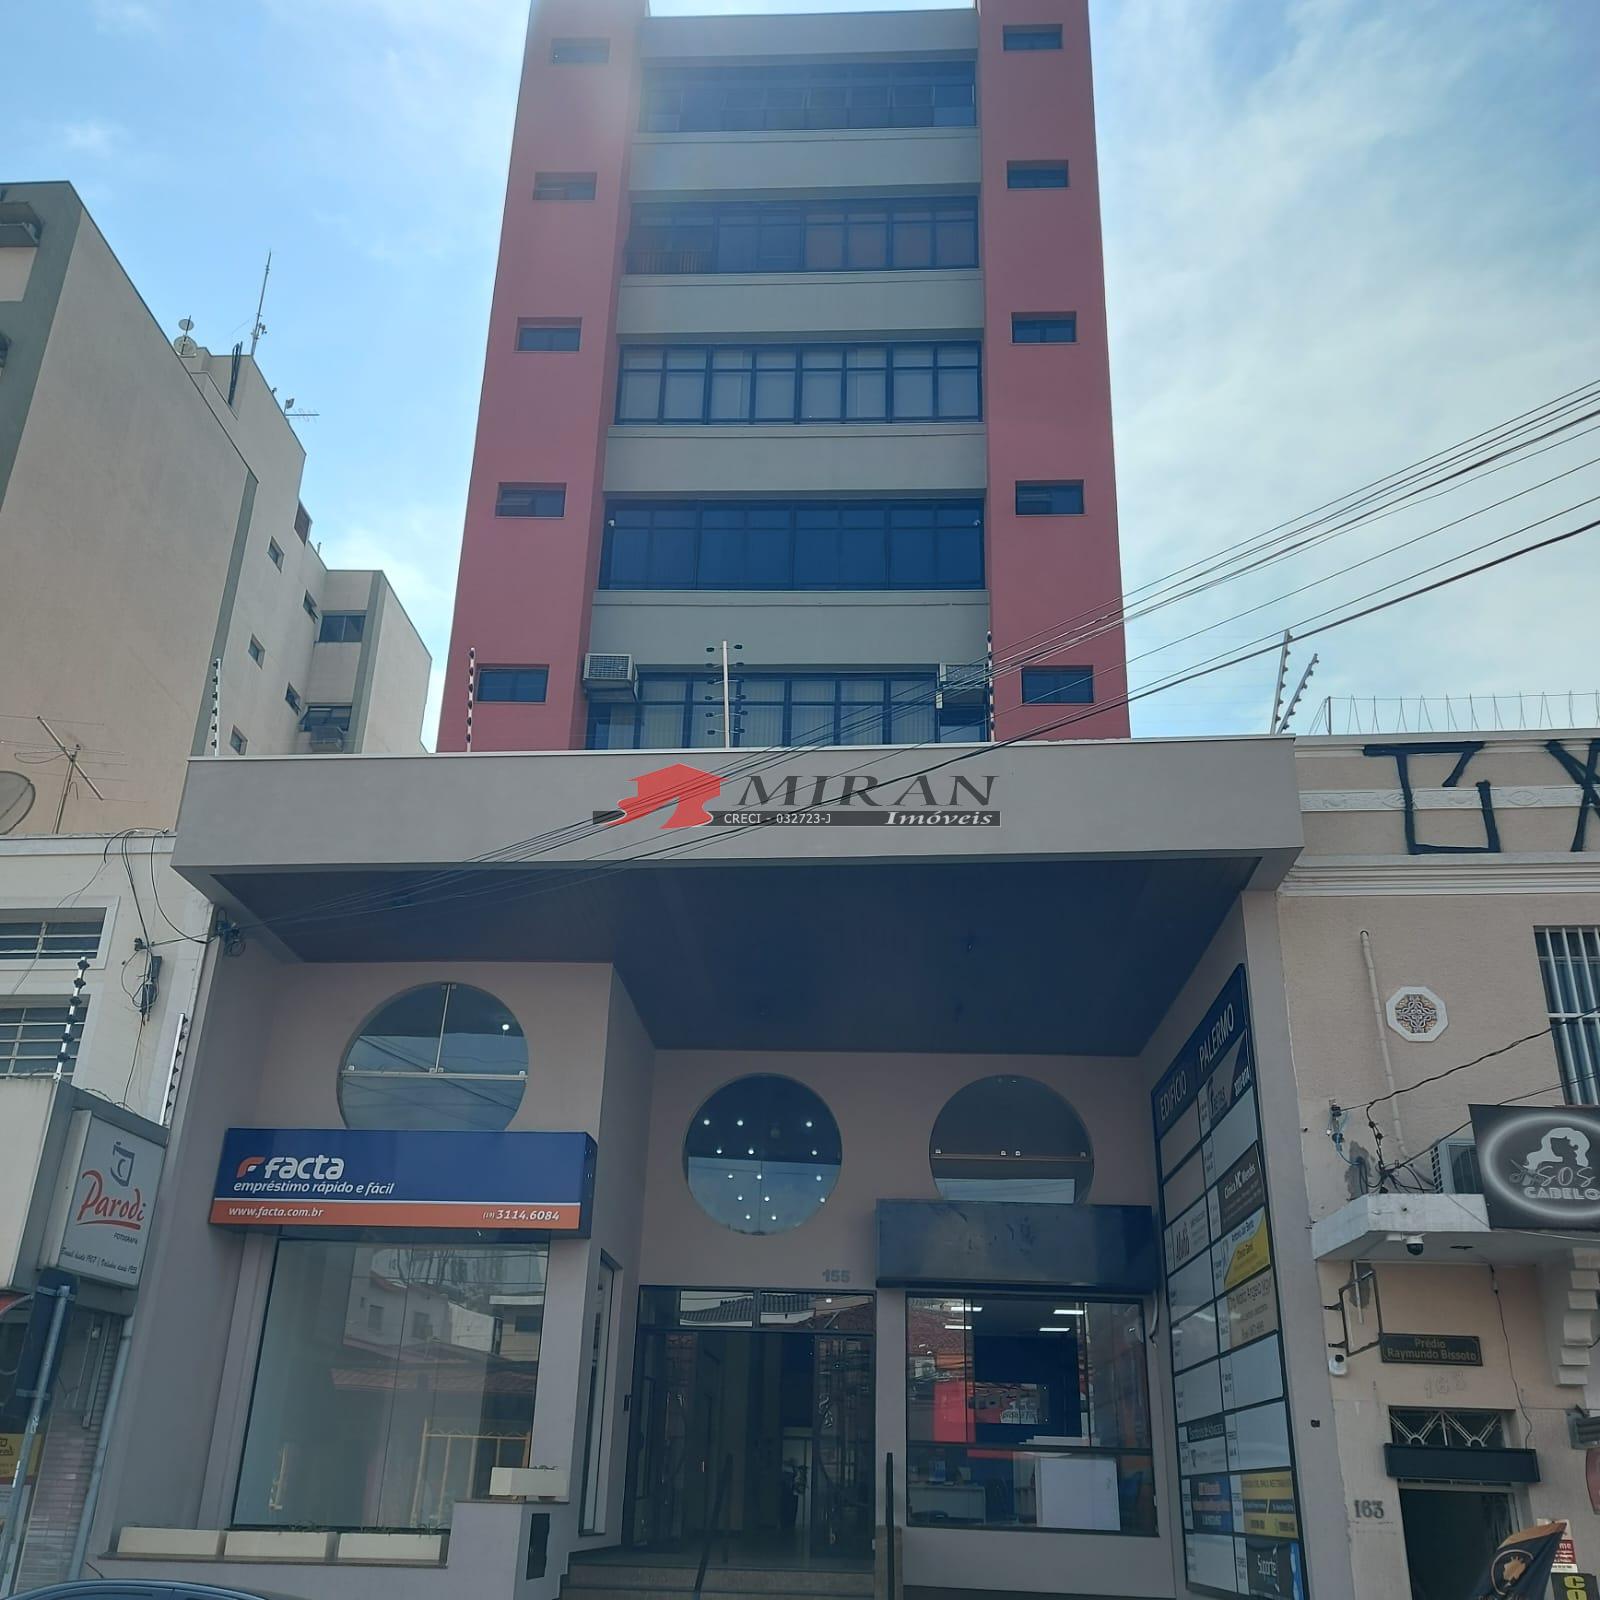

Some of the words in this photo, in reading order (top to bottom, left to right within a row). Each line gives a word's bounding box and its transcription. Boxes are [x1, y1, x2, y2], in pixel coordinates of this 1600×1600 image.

[1199, 1003, 1234, 1073] PALERMO
[264, 1154, 345, 1180] facta
[1537, 1165, 1596, 1188] SOS
[77, 1169, 147, 1222] Parodi
[233, 1180, 310, 1196] empréstimo
[312, 1181, 353, 1195] rápido
[356, 1185, 364, 1193] e
[364, 1182, 395, 1197] fácil
[229, 1206, 324, 1218] www.facta.com.br
[496, 1209, 560, 1221] 3114.6084
[822, 1269, 850, 1283] 155
[1388, 1348, 1440, 1362] Raymundo
[1441, 1349, 1477, 1361] Bissoto
[1354, 1500, 1385, 1519] 163
